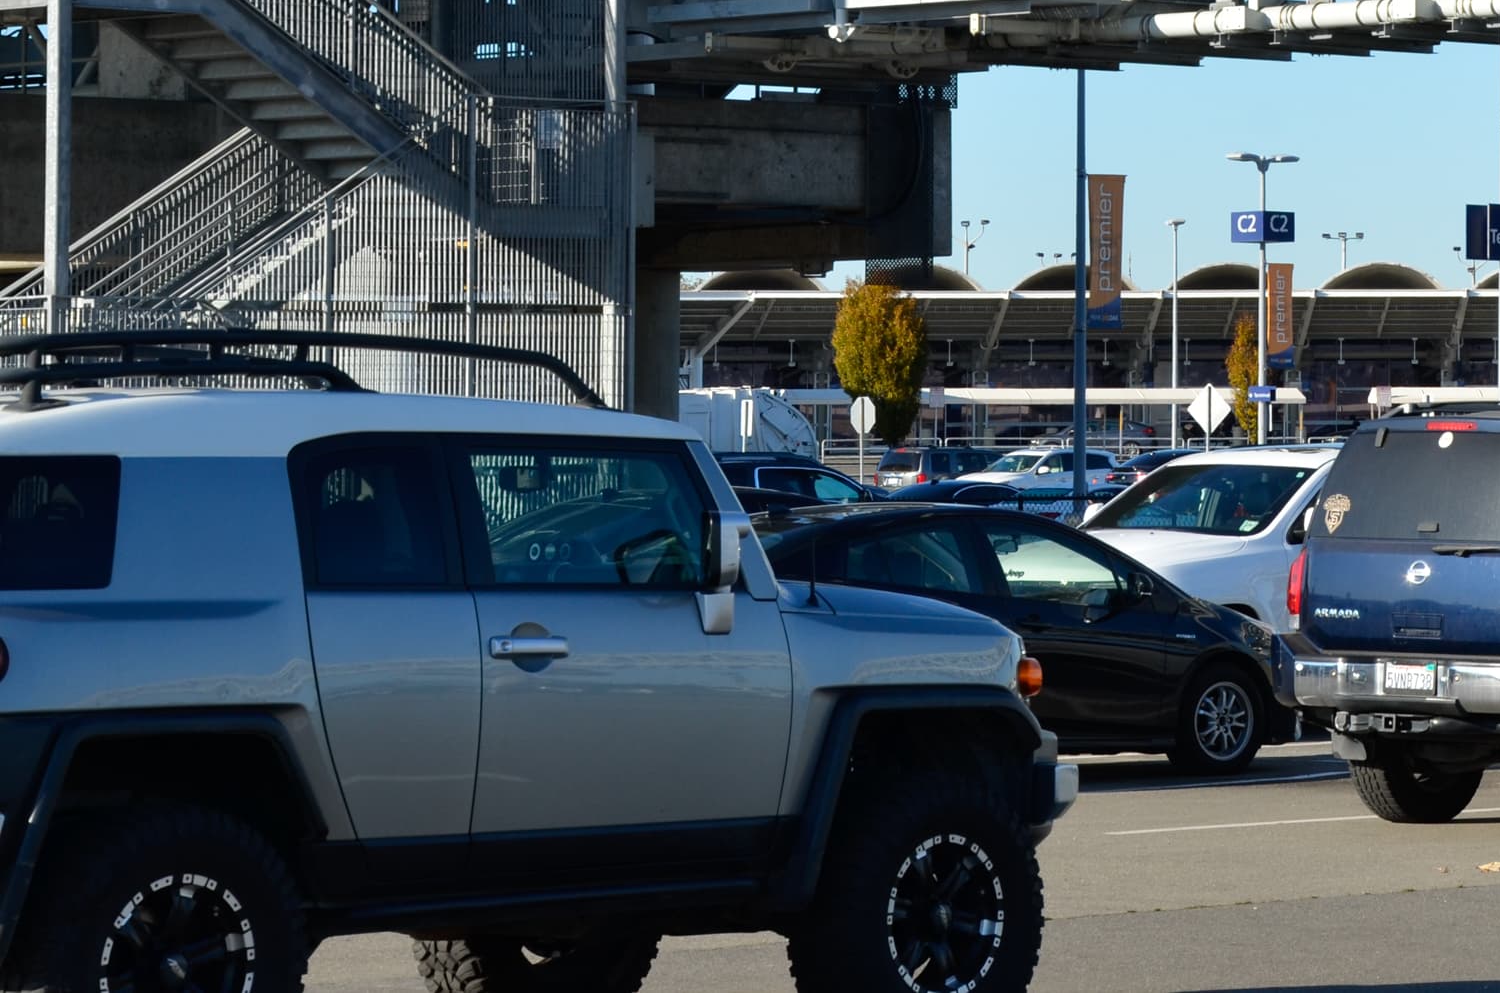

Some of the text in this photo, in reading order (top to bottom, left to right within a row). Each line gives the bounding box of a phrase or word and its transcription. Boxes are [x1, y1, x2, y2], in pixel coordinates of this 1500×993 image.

[1237, 214, 1256, 233] C2
[1269, 214, 1288, 233] C2
[1098, 183, 1114, 292] premier
[1276, 269, 1288, 344] premier
[1314, 608, 1360, 619] ARMADA
